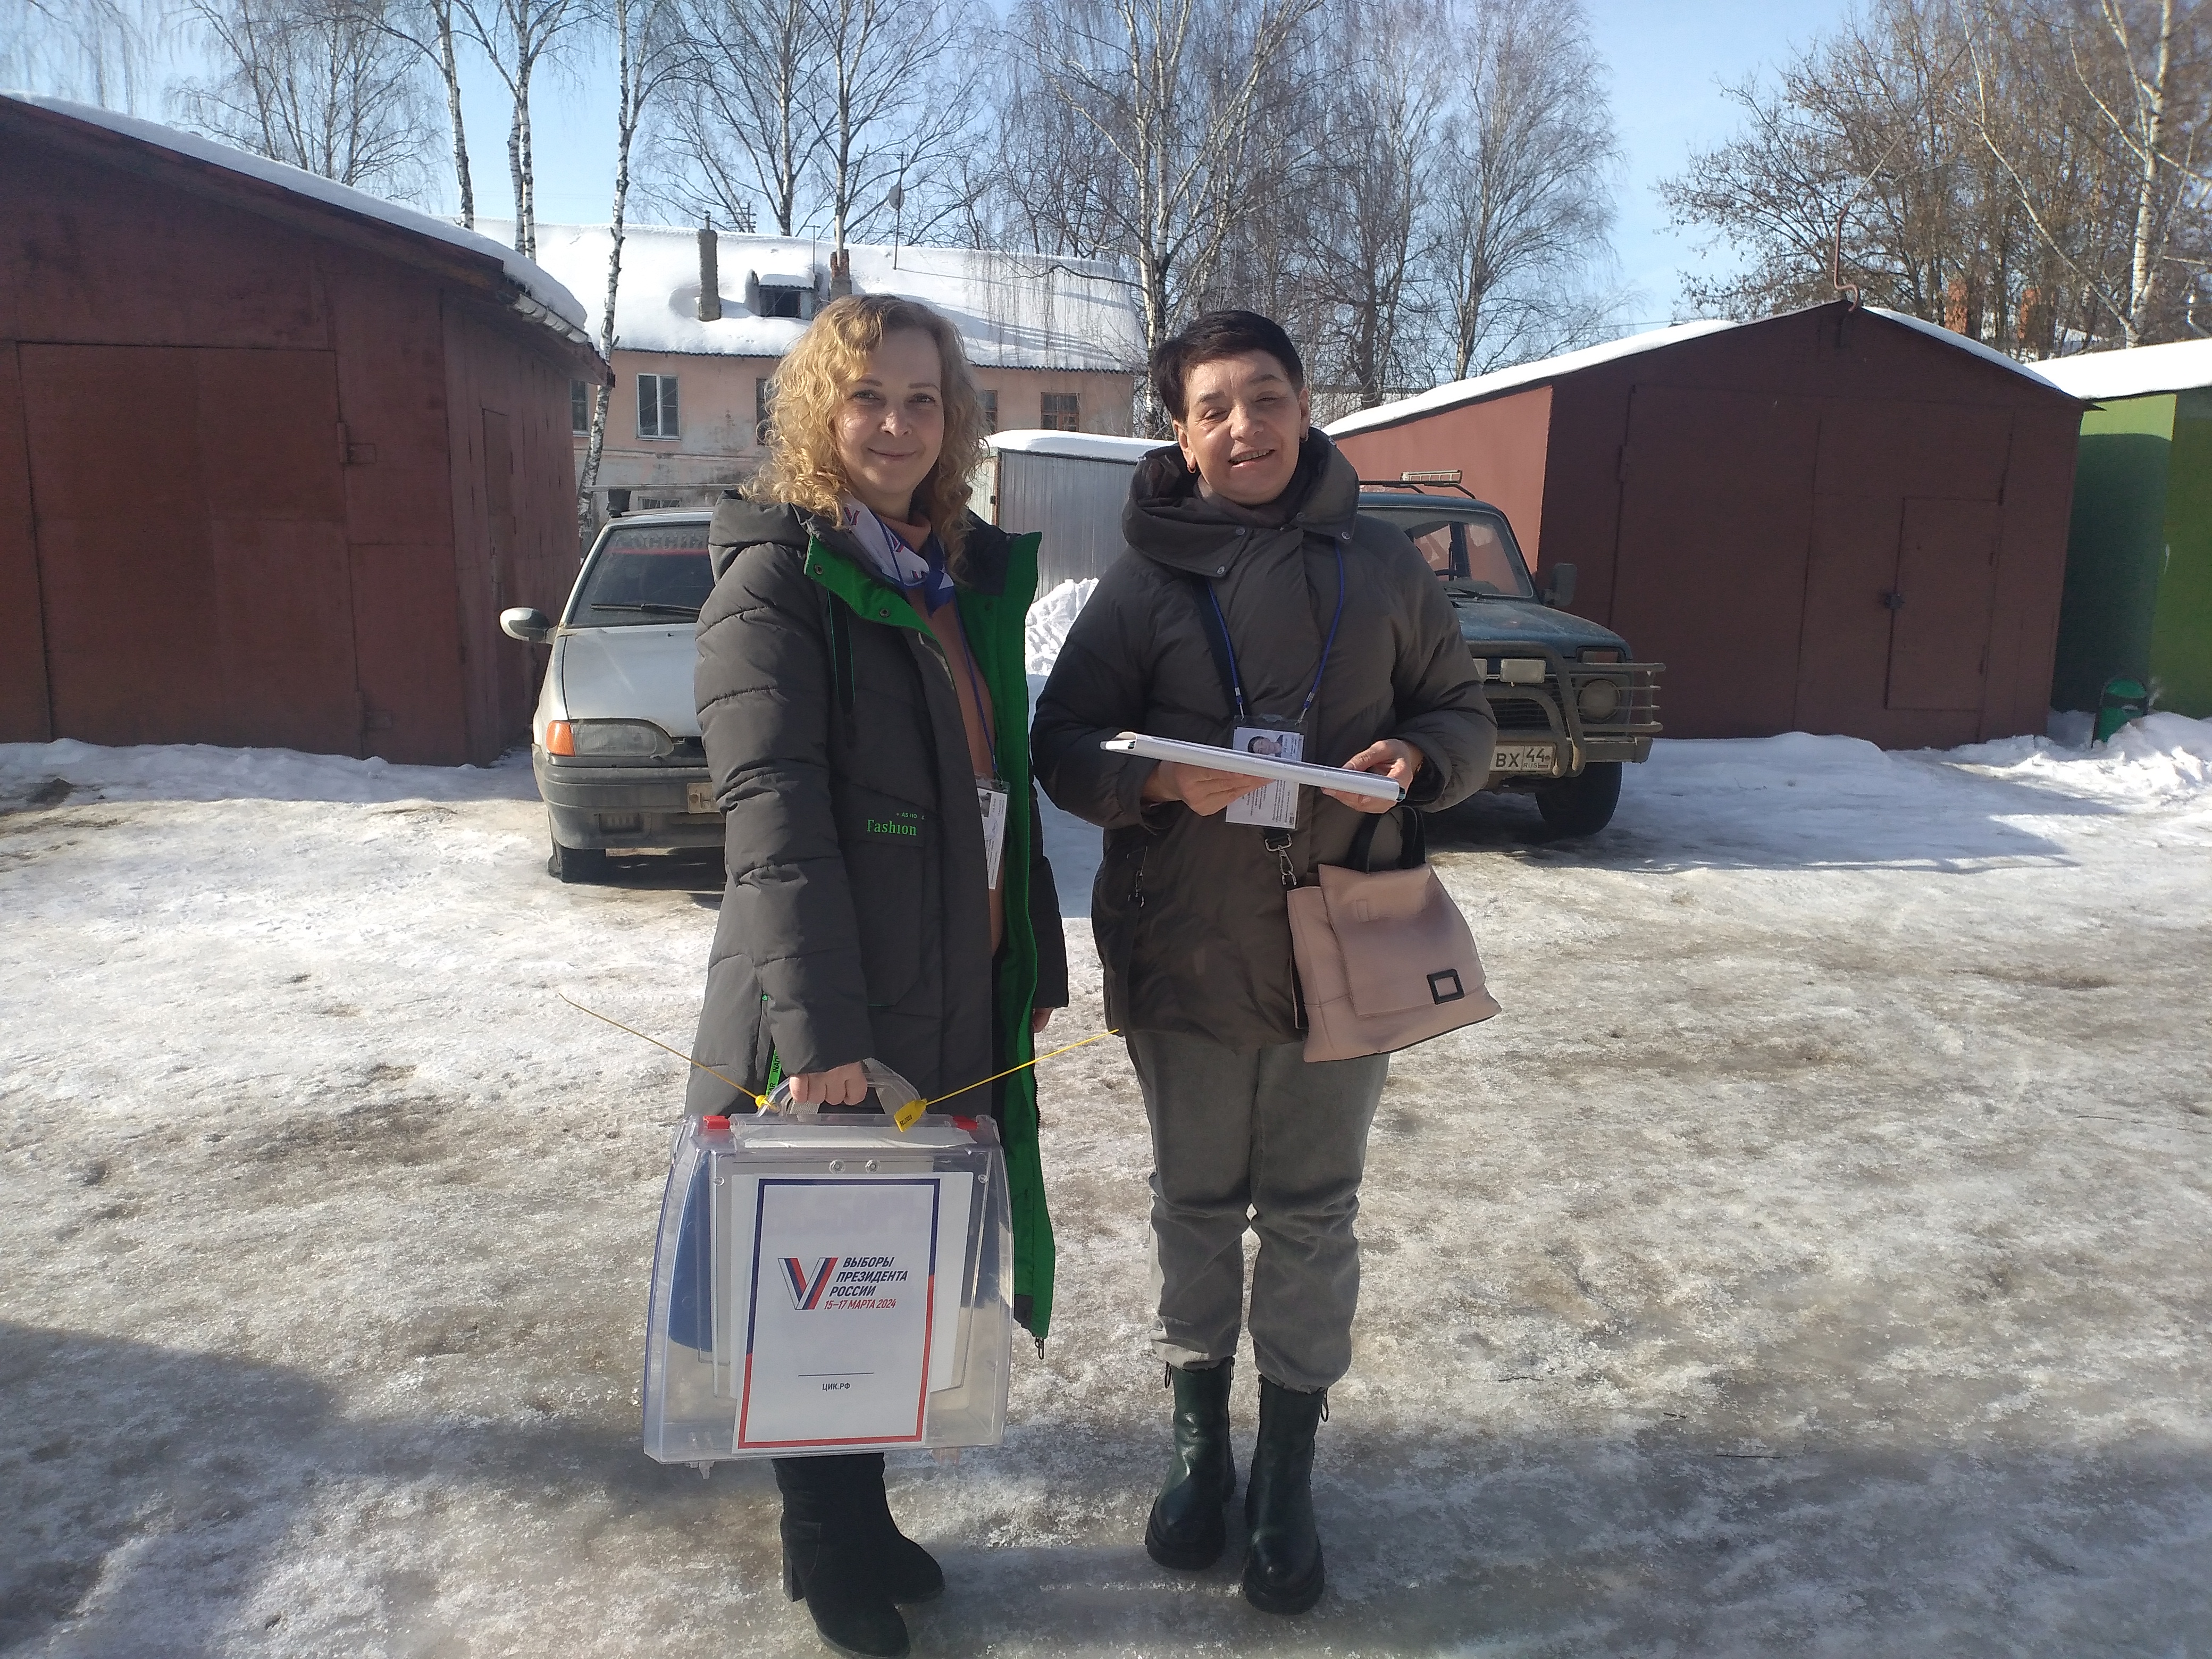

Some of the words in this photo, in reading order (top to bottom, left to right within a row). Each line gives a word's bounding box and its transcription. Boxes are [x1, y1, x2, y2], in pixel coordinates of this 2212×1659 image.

[1526, 748, 1545, 763] 44
[867, 819, 916, 836] Fashion
[842, 1256, 895, 1268] ВЫБОРЫ
[835, 1270, 908, 1283] ПРЕЗИДЕНТА
[828, 1285, 877, 1297] РОССИИ
[847, 1299, 876, 1310] МАРТА
[876, 1298, 896, 1309] 2024
[822, 1382, 851, 1391] ЦИК.РФ
